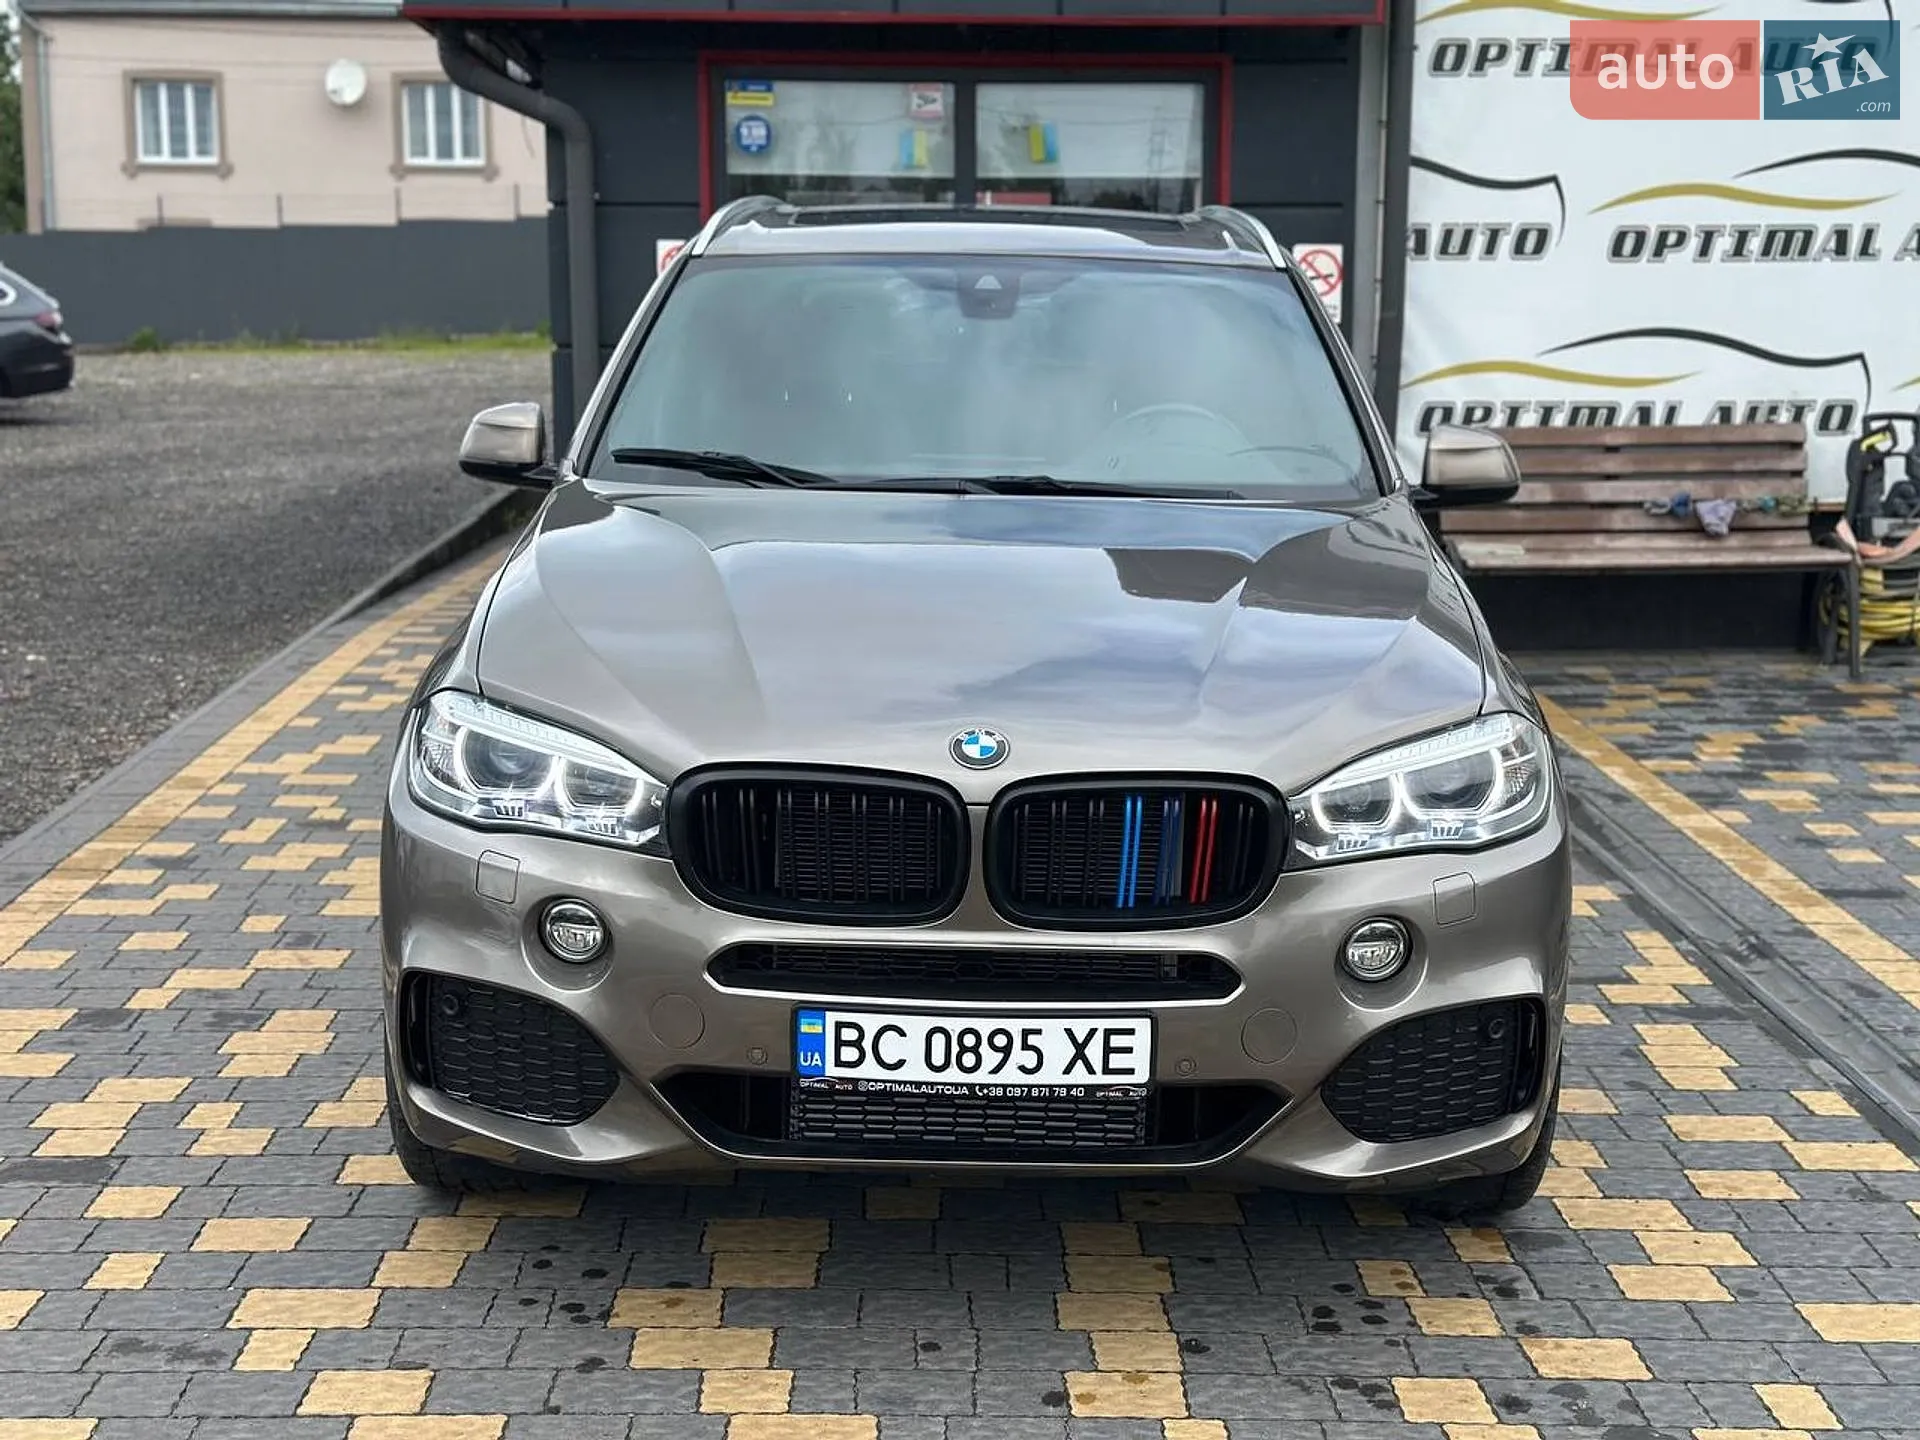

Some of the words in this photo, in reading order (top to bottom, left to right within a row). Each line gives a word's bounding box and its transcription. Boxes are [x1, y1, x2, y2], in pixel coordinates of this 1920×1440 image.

[1606, 223, 1882, 263] OPTIMAL
[799, 1051, 823, 1067] UA
[834, 1020, 907, 1071] BC
[924, 1026, 1044, 1075] 0895
[1062, 1027, 1136, 1075] XE
[1006, 1086, 1029, 1097] 097
[1031, 1086, 1050, 1097] 871
[1070, 1086, 1085, 1097] 40
